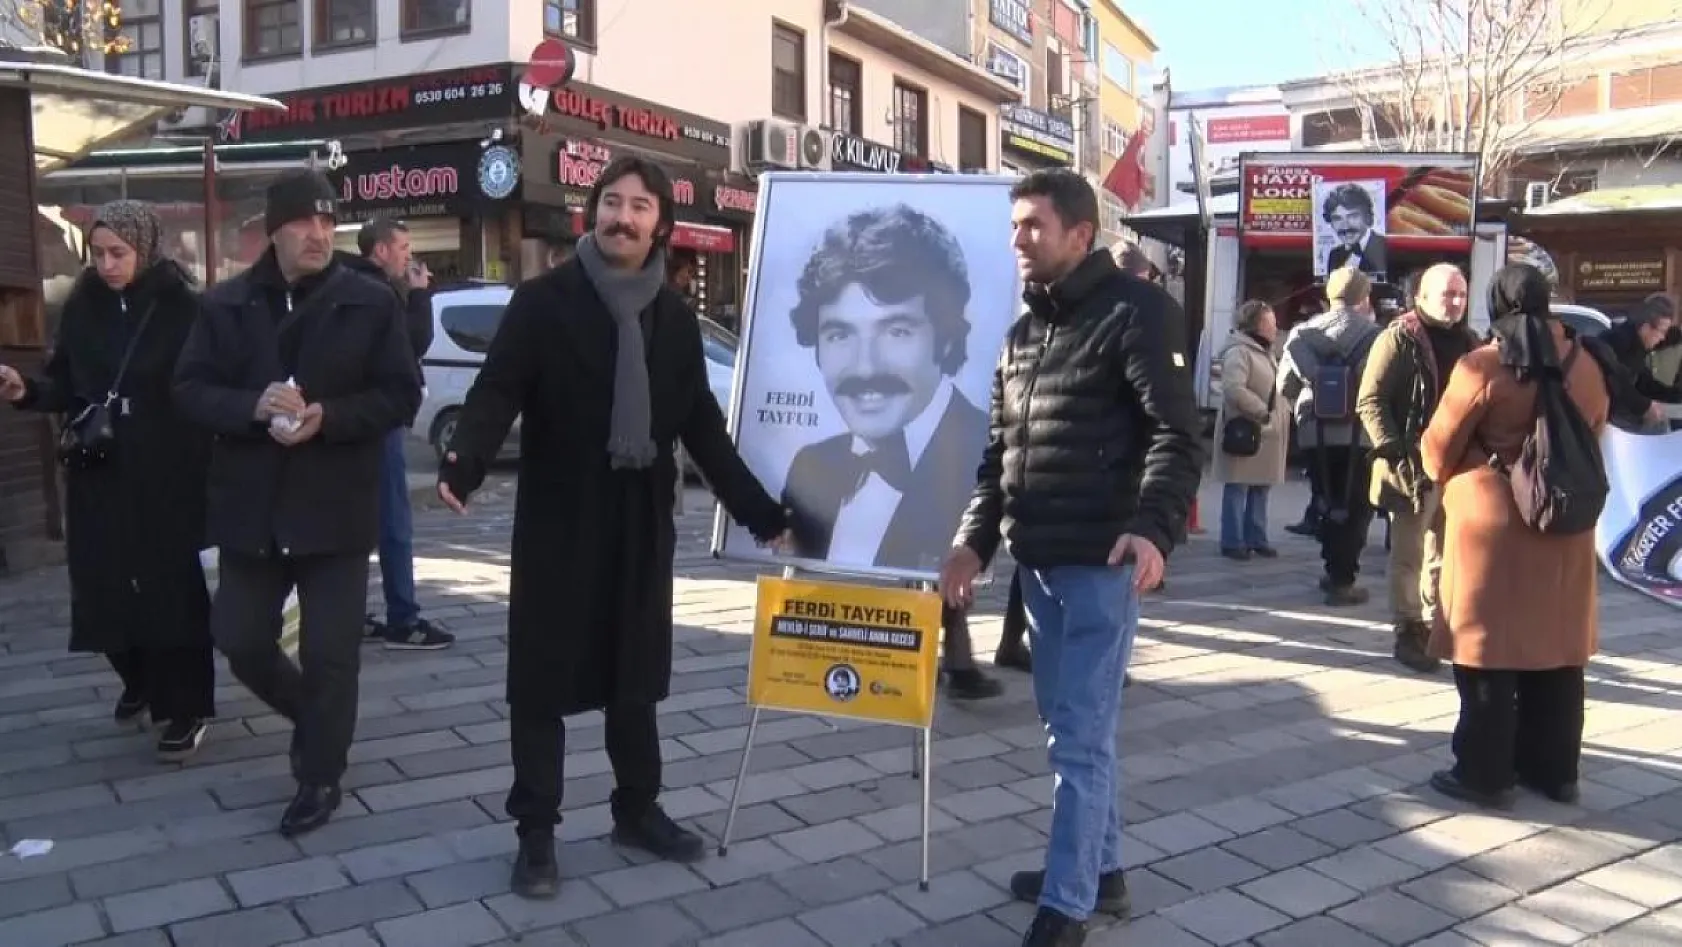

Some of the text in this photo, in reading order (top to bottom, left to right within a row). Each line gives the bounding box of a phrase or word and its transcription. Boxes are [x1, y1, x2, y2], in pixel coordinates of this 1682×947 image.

[616, 104, 679, 141] TURİZM
[847, 137, 902, 175] KILAVUZ
[357, 163, 459, 200] ustam
[1253, 188, 1311, 198] LOKM
[766, 390, 815, 407] FERDİ
[756, 410, 819, 428] TAYFUR
[783, 599, 912, 627] FERDİ TAYFUR
